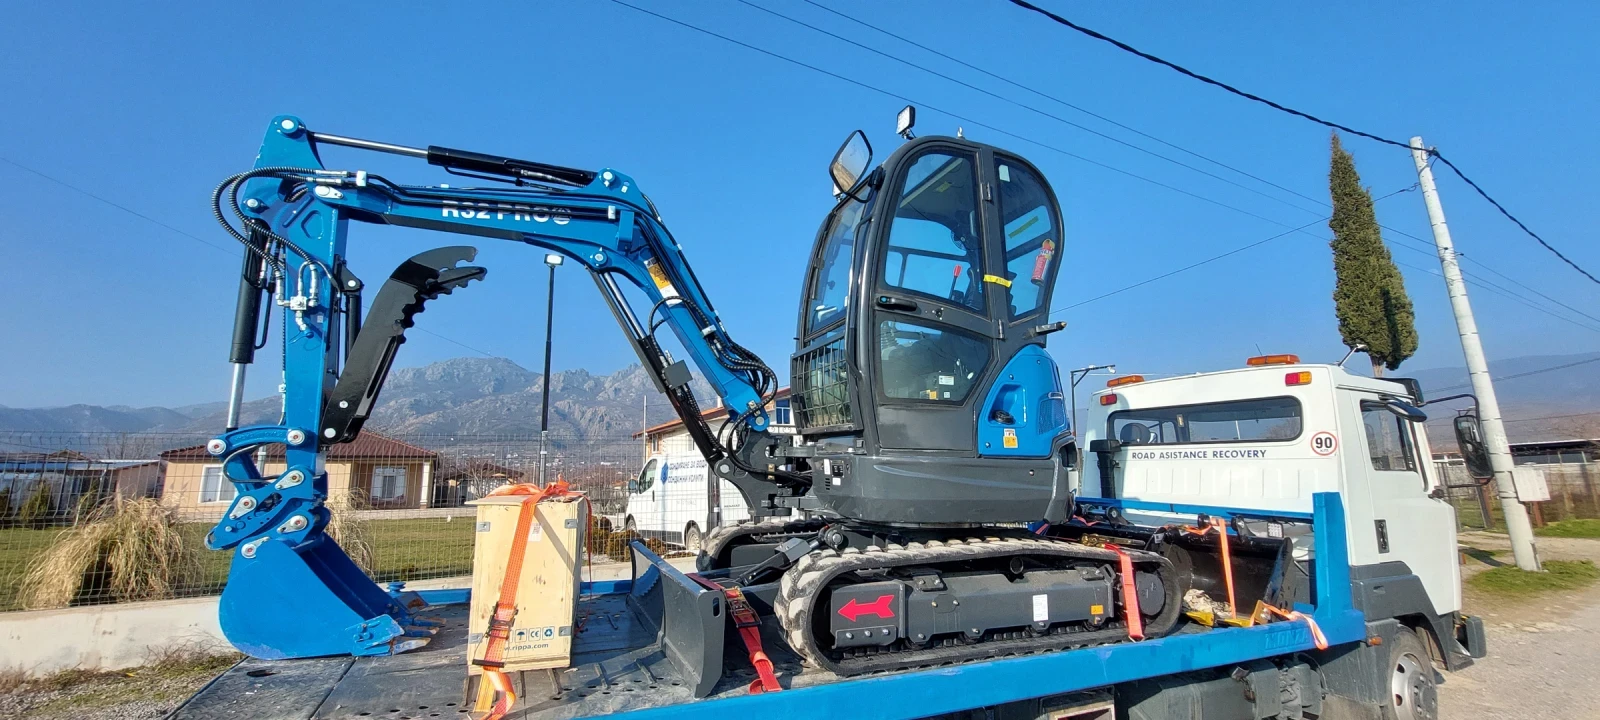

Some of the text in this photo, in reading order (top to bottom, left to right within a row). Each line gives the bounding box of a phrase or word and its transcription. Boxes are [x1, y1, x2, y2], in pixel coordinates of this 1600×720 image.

[442, 200, 491, 219] R32
[1315, 436, 1333, 449] 90
[1131, 449, 1267, 460] ROAD ASISTANCE RECOVERY
